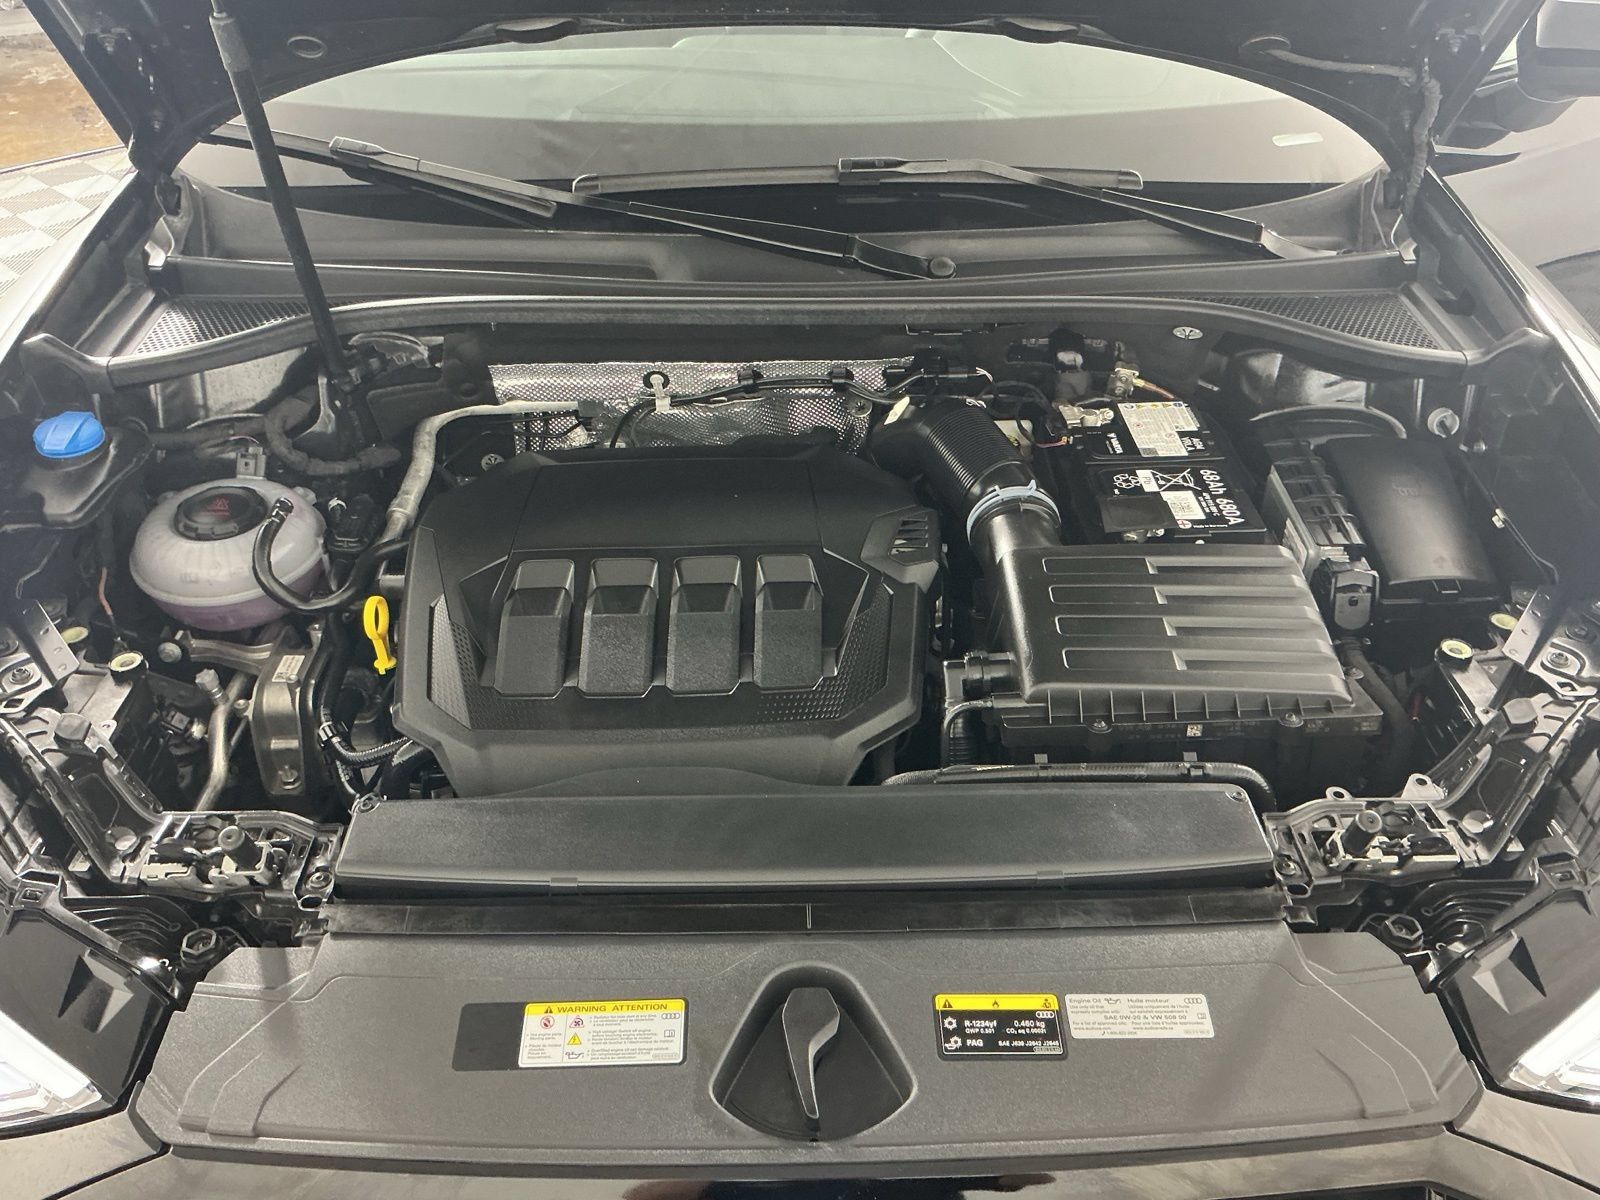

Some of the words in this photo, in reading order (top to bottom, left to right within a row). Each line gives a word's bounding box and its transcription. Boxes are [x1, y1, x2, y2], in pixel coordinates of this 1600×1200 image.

[1141, 476, 1152, 485] Pb
[1199, 469, 1227, 495] 68Ah
[1215, 498, 1245, 525] 680A
[556, 1005, 607, 1013] WARNING
[611, 1003, 668, 1012] ATTENTION
[964, 1019, 997, 1029] R-1234yf
[1035, 1020, 1046, 1028] kg
[966, 1039, 984, 1047] PAG
